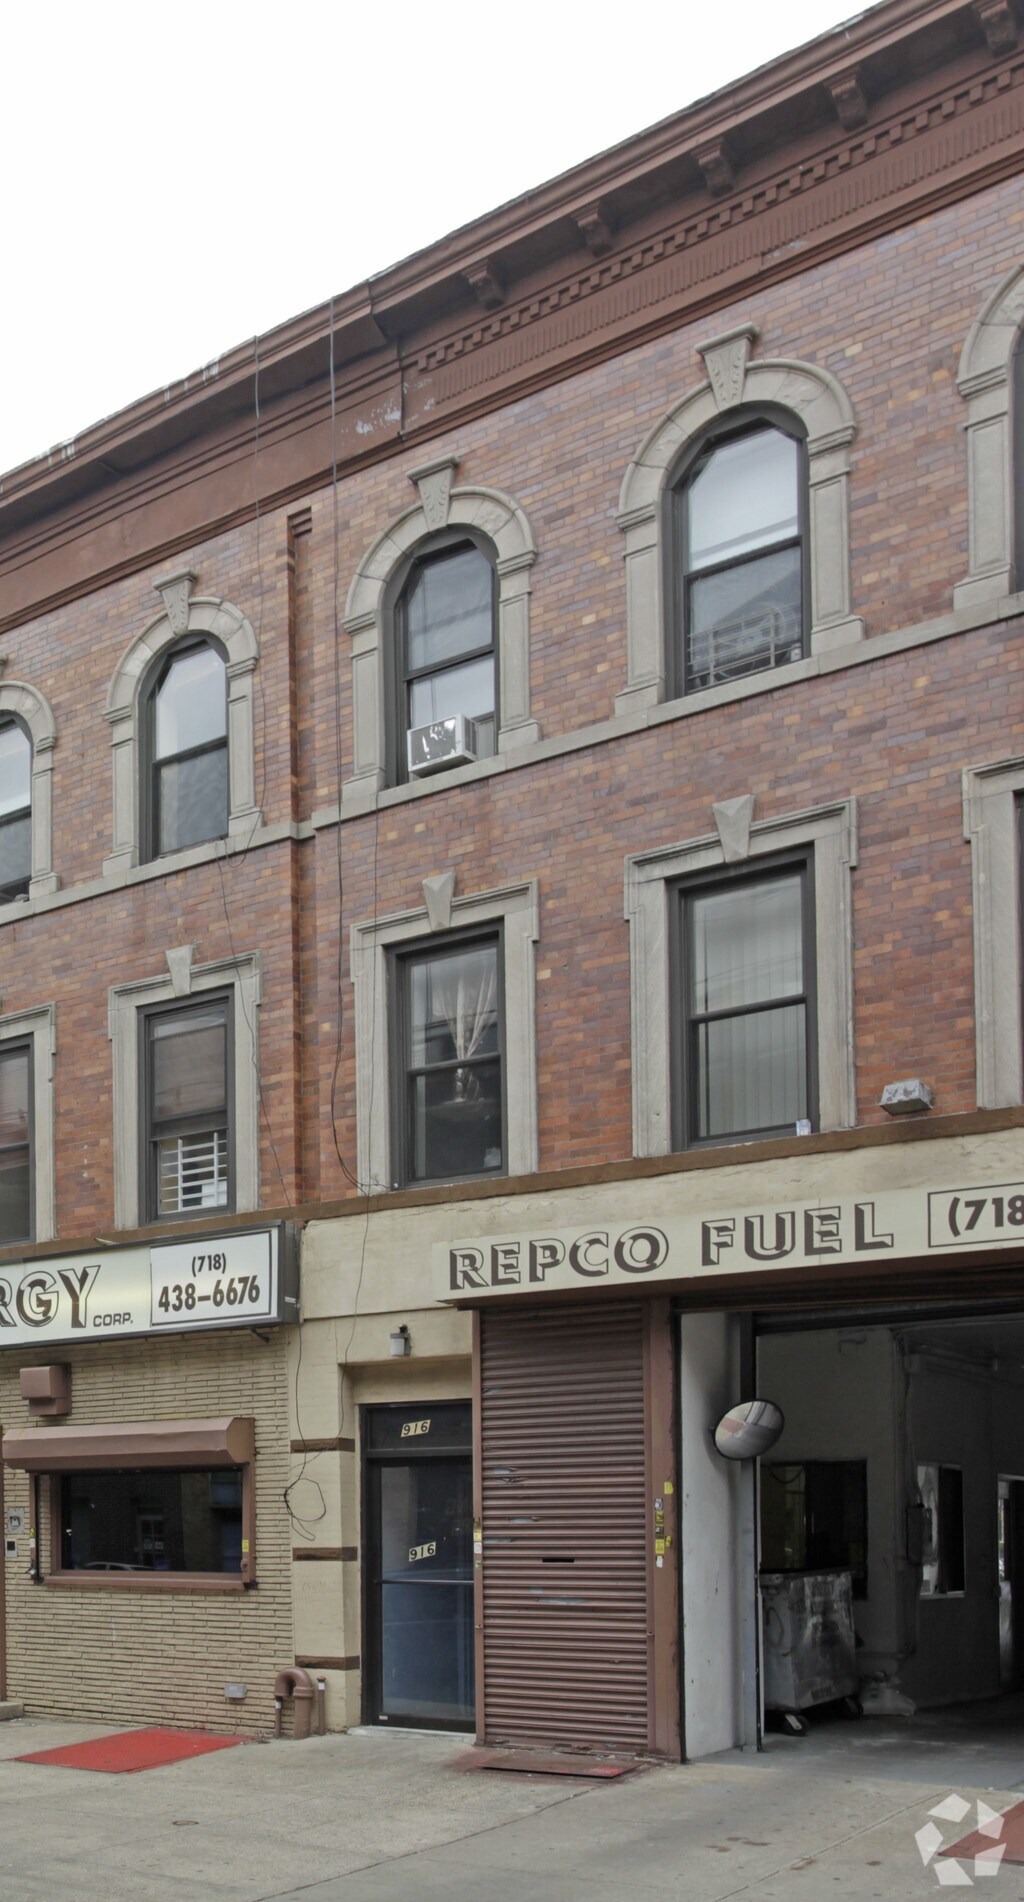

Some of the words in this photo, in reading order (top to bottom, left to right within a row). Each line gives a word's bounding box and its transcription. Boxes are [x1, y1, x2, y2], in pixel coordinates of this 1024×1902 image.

[450, 1226, 669, 1290] REPCO
[701, 1202, 894, 1266] FUEL
[192, 1253, 226, 1277] (718)
[158, 1275, 260, 1313] 438-6676
[93, 1312, 133, 1327] CORP.
[403, 1422, 428, 1436] 916
[410, 1543, 435, 1560] 916
